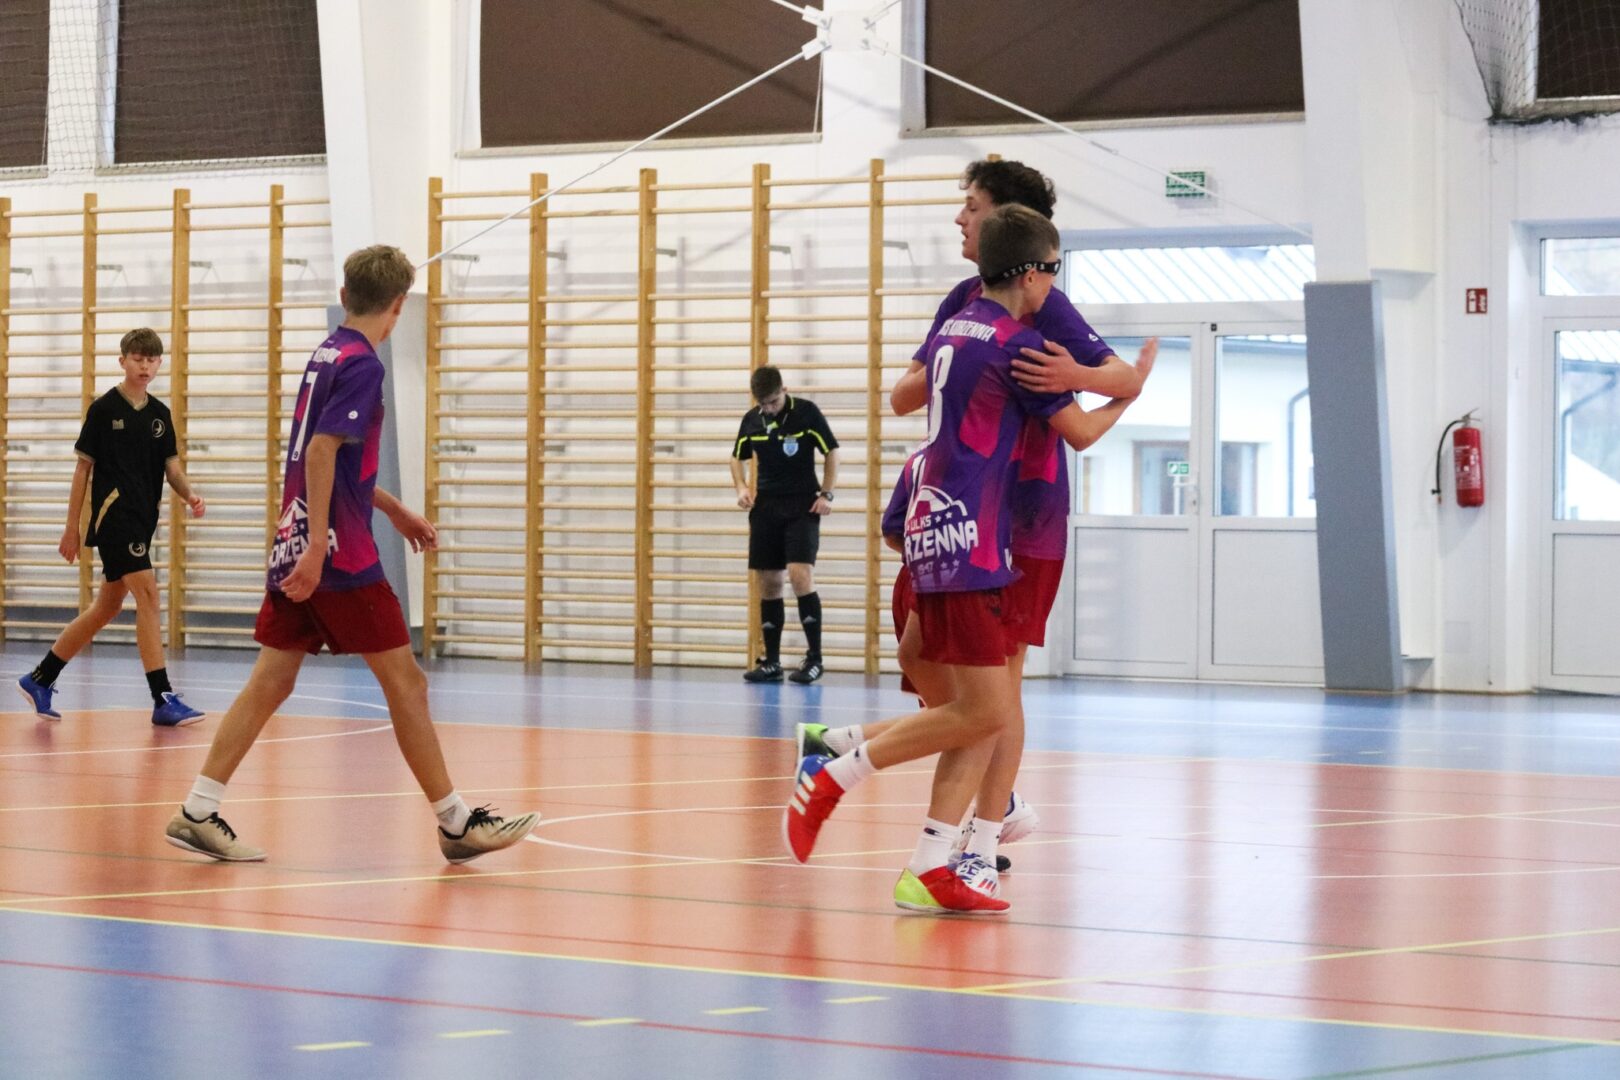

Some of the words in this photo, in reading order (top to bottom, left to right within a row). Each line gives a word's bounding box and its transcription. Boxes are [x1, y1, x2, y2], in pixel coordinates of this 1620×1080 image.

[291, 371, 319, 461] 7
[268, 527, 340, 570] ORZENA
[904, 519, 979, 567] RZENNA
